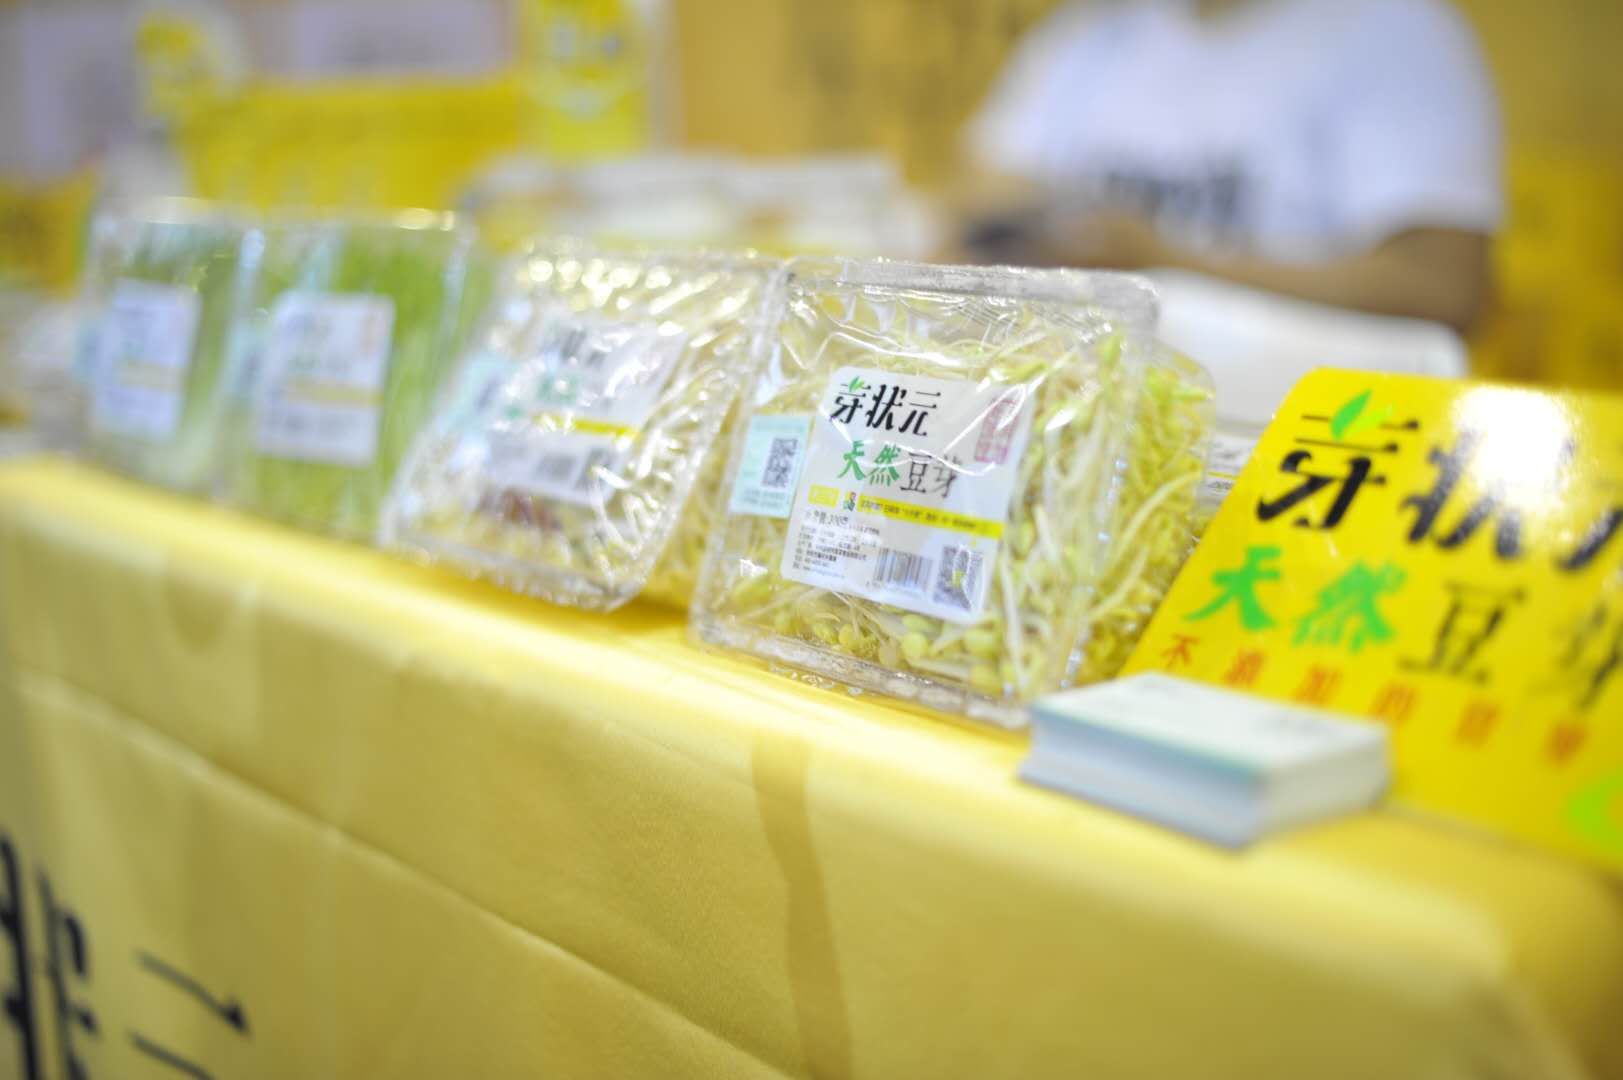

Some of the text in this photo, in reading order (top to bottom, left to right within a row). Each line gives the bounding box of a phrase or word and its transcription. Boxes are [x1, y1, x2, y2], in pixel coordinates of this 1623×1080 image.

[830, 376, 941, 437] 芽状元
[837, 440, 962, 499] 天然豆芽
